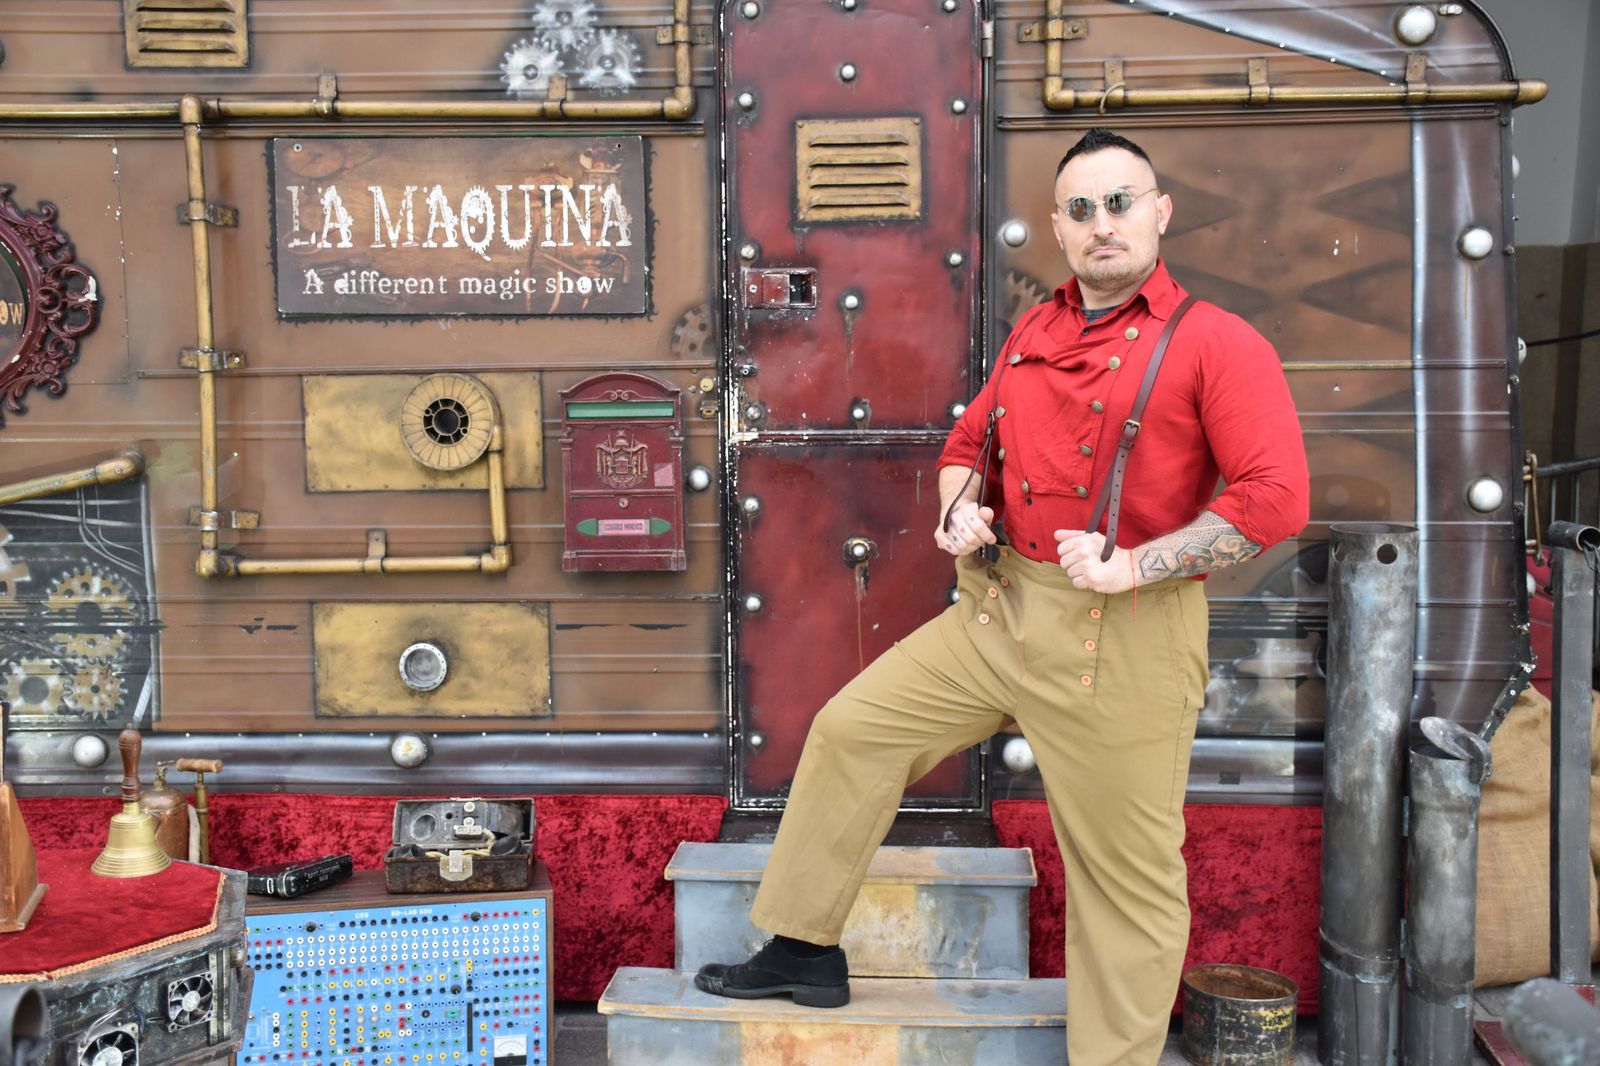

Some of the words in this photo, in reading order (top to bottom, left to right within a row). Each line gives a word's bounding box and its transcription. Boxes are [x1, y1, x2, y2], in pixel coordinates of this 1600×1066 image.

[286, 184, 353, 249] LA
[368, 184, 633, 261] MAQUINA
[302, 268, 324, 295] A
[334, 270, 448, 295] different
[458, 269, 537, 300] magic
[545, 271, 615, 294] show
